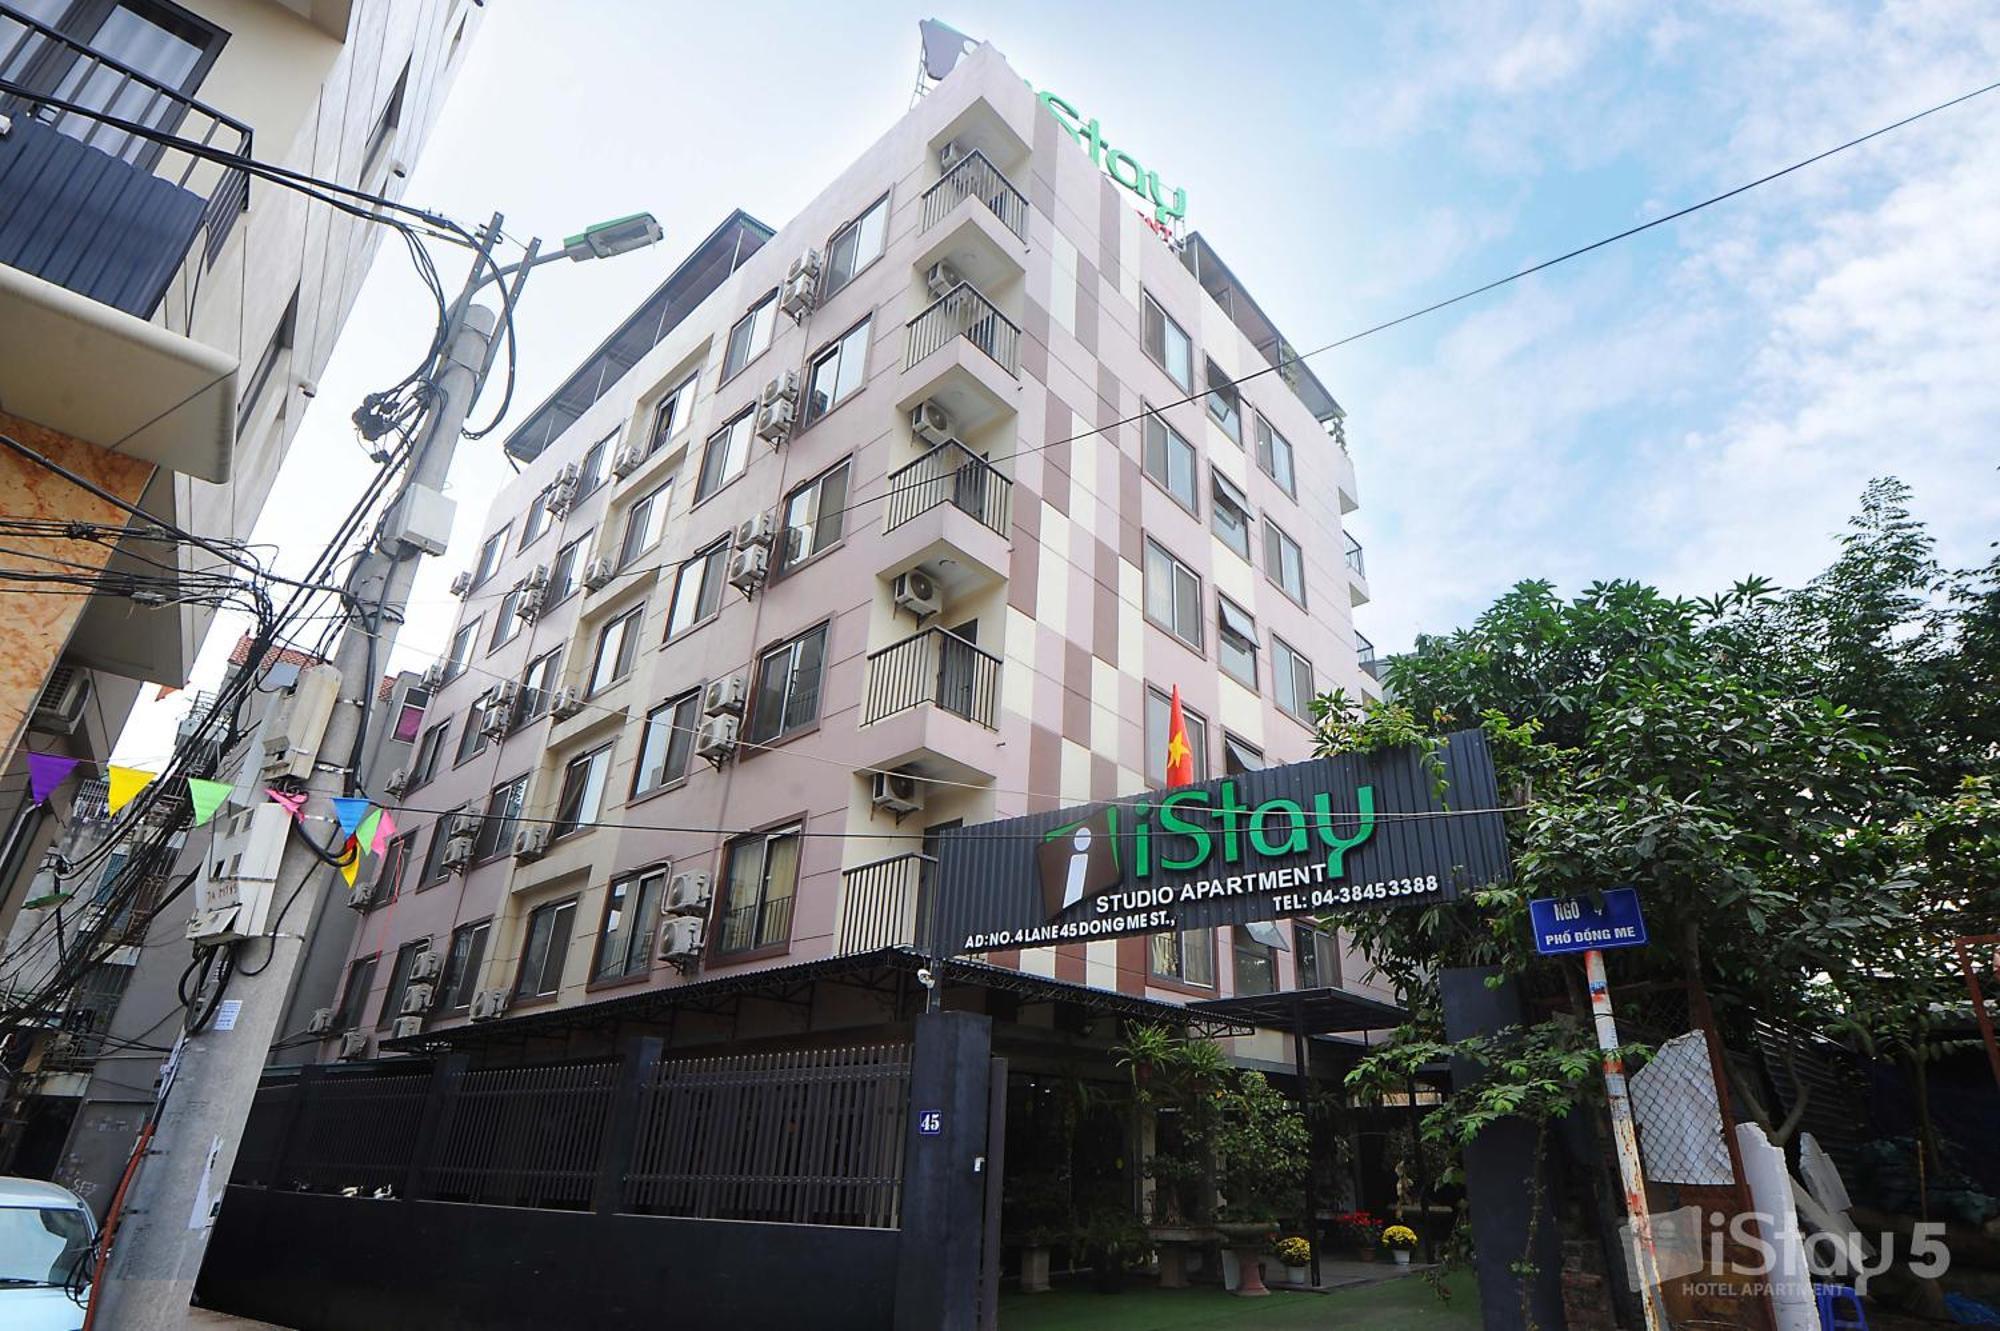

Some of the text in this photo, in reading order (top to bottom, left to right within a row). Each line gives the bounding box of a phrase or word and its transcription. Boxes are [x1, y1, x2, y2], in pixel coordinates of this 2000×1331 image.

[1024, 79, 1186, 225] Stay
[1135, 780, 1376, 879] iStay
[1096, 863, 1327, 913] STUDIO APARTMENT
[1273, 875, 1438, 911] TEL: 04-38453388
[1025, 925, 1058, 943] LANE
[1060, 923, 1077, 937] 45
[1079, 918, 1125, 935] DONG
[1127, 913, 1147, 929] ME
[921, 1113, 940, 1131] 45
